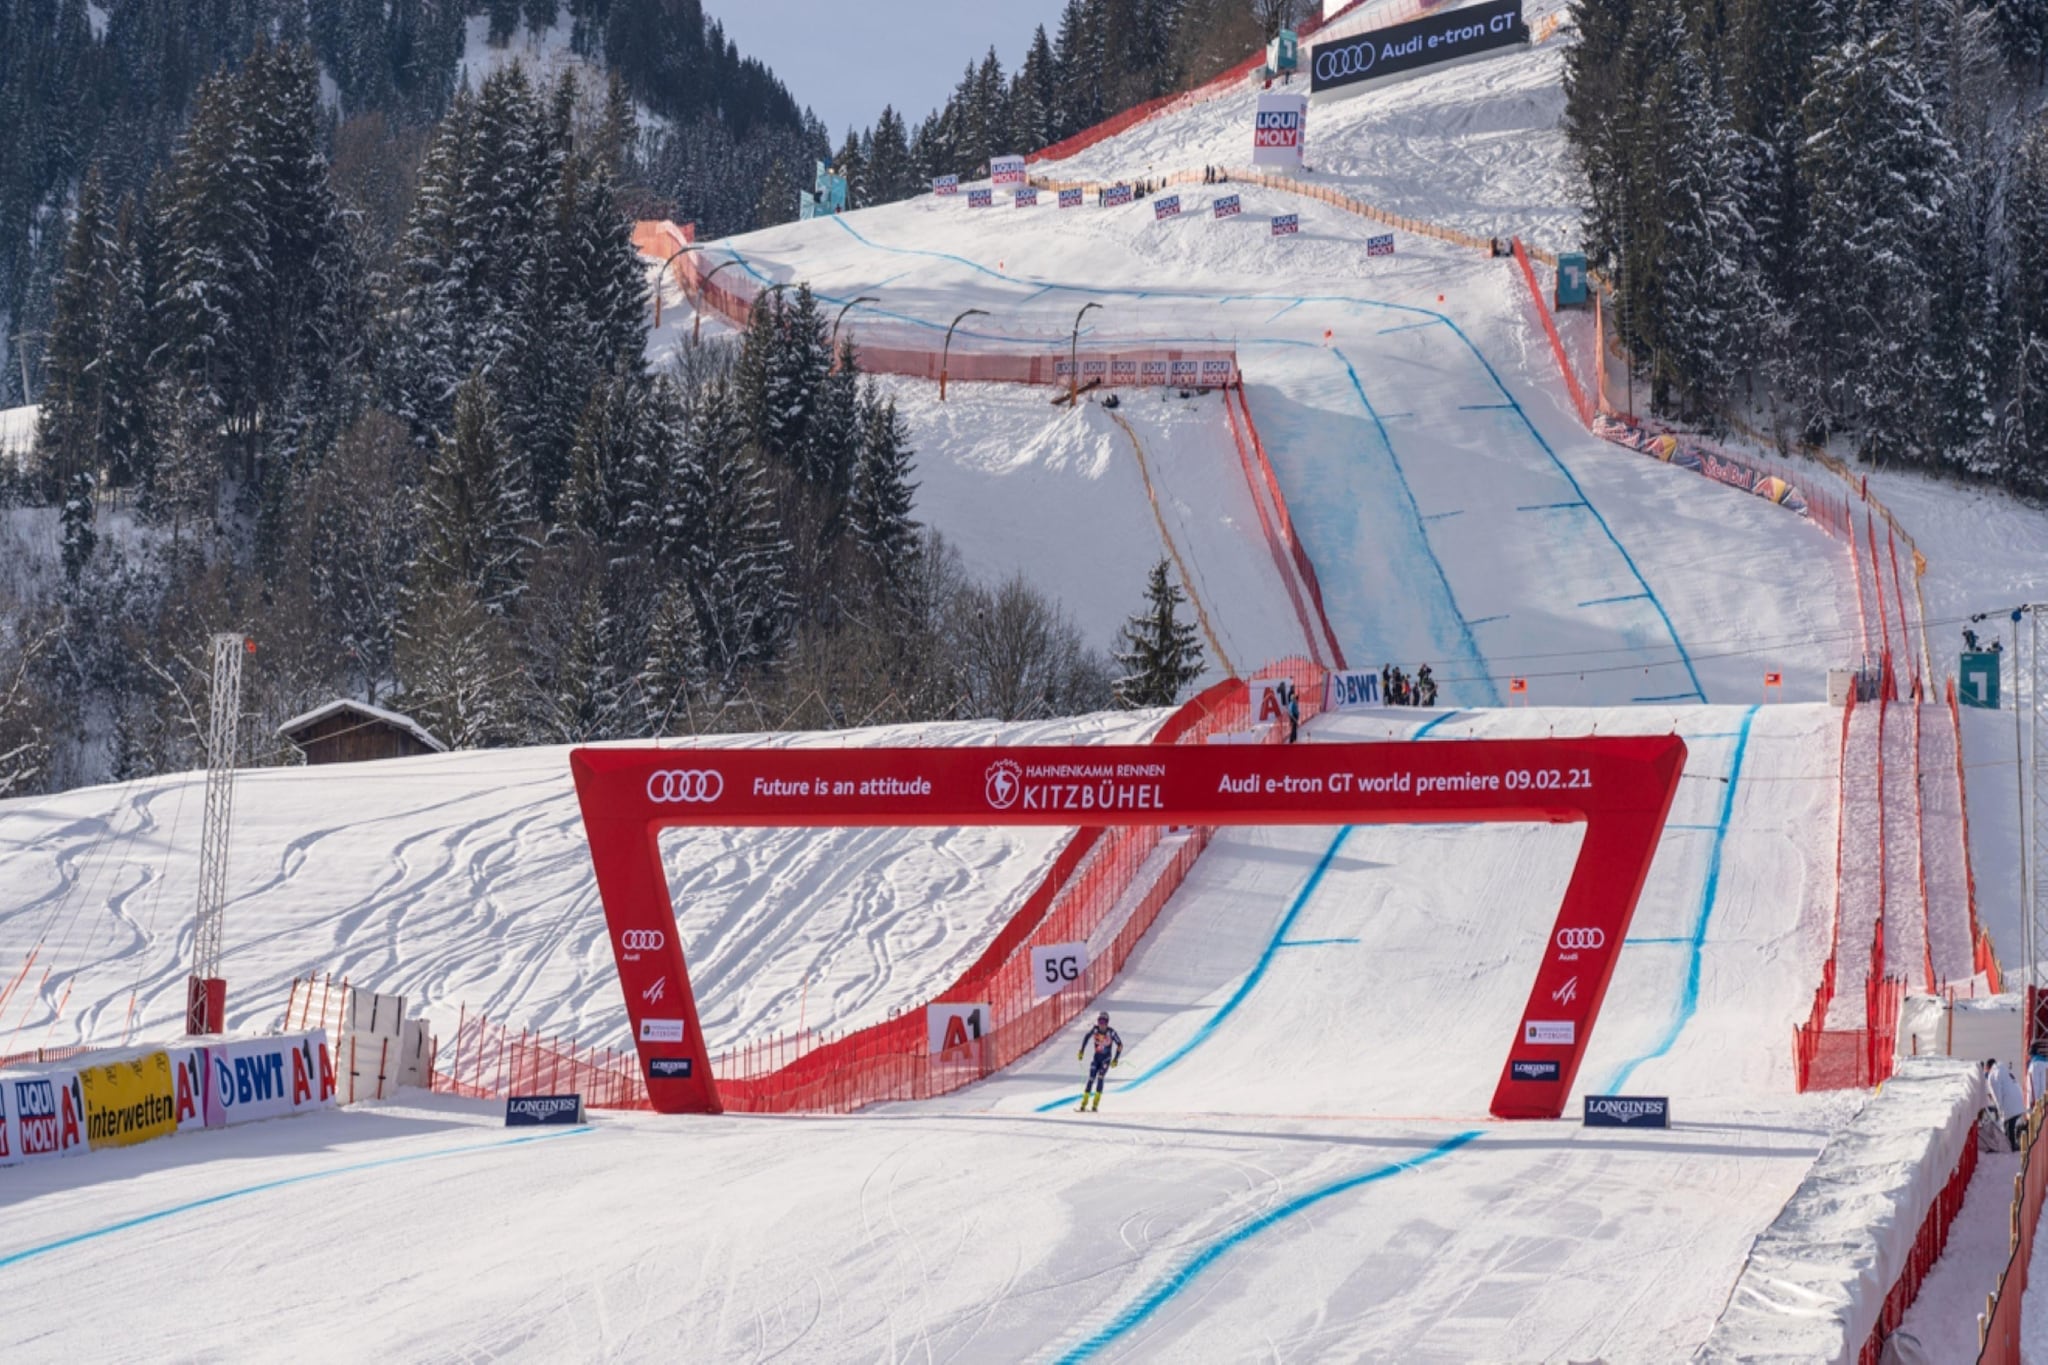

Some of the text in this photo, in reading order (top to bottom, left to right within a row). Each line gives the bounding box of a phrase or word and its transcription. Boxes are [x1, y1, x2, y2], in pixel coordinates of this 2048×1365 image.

[1381, 12, 1515, 60] Audi e-tron GT
[1257, 112, 1297, 128] LIQUI
[1256, 130, 1297, 145] MOLY
[992, 172, 1017, 184] MOLY
[1260, 682, 1287, 720] A1
[1346, 674, 1379, 704] BWT
[1025, 764, 1166, 778] HAHNENKAMM RENNEN
[1218, 769, 1592, 796] Audi e-tron GT world premiere 09.02.21
[753, 776, 931, 796] Future is an attitude
[1023, 780, 1164, 809] KITZBÜHEL
[1045, 956, 1079, 983] 5G
[940, 1008, 982, 1062] A1
[234, 1052, 284, 1104] BWT
[293, 1038, 314, 1106] A1
[1514, 1063, 1556, 1073] LONGINES
[17, 1081, 55, 1116] LIQUI
[176, 1052, 199, 1124] A1
[62, 1075, 83, 1151] A1
[88, 1093, 174, 1141] interwetten
[510, 1099, 576, 1113] LONGINES
[1588, 1100, 1664, 1114] LONGINES
[21, 1118, 58, 1152] MOLY
